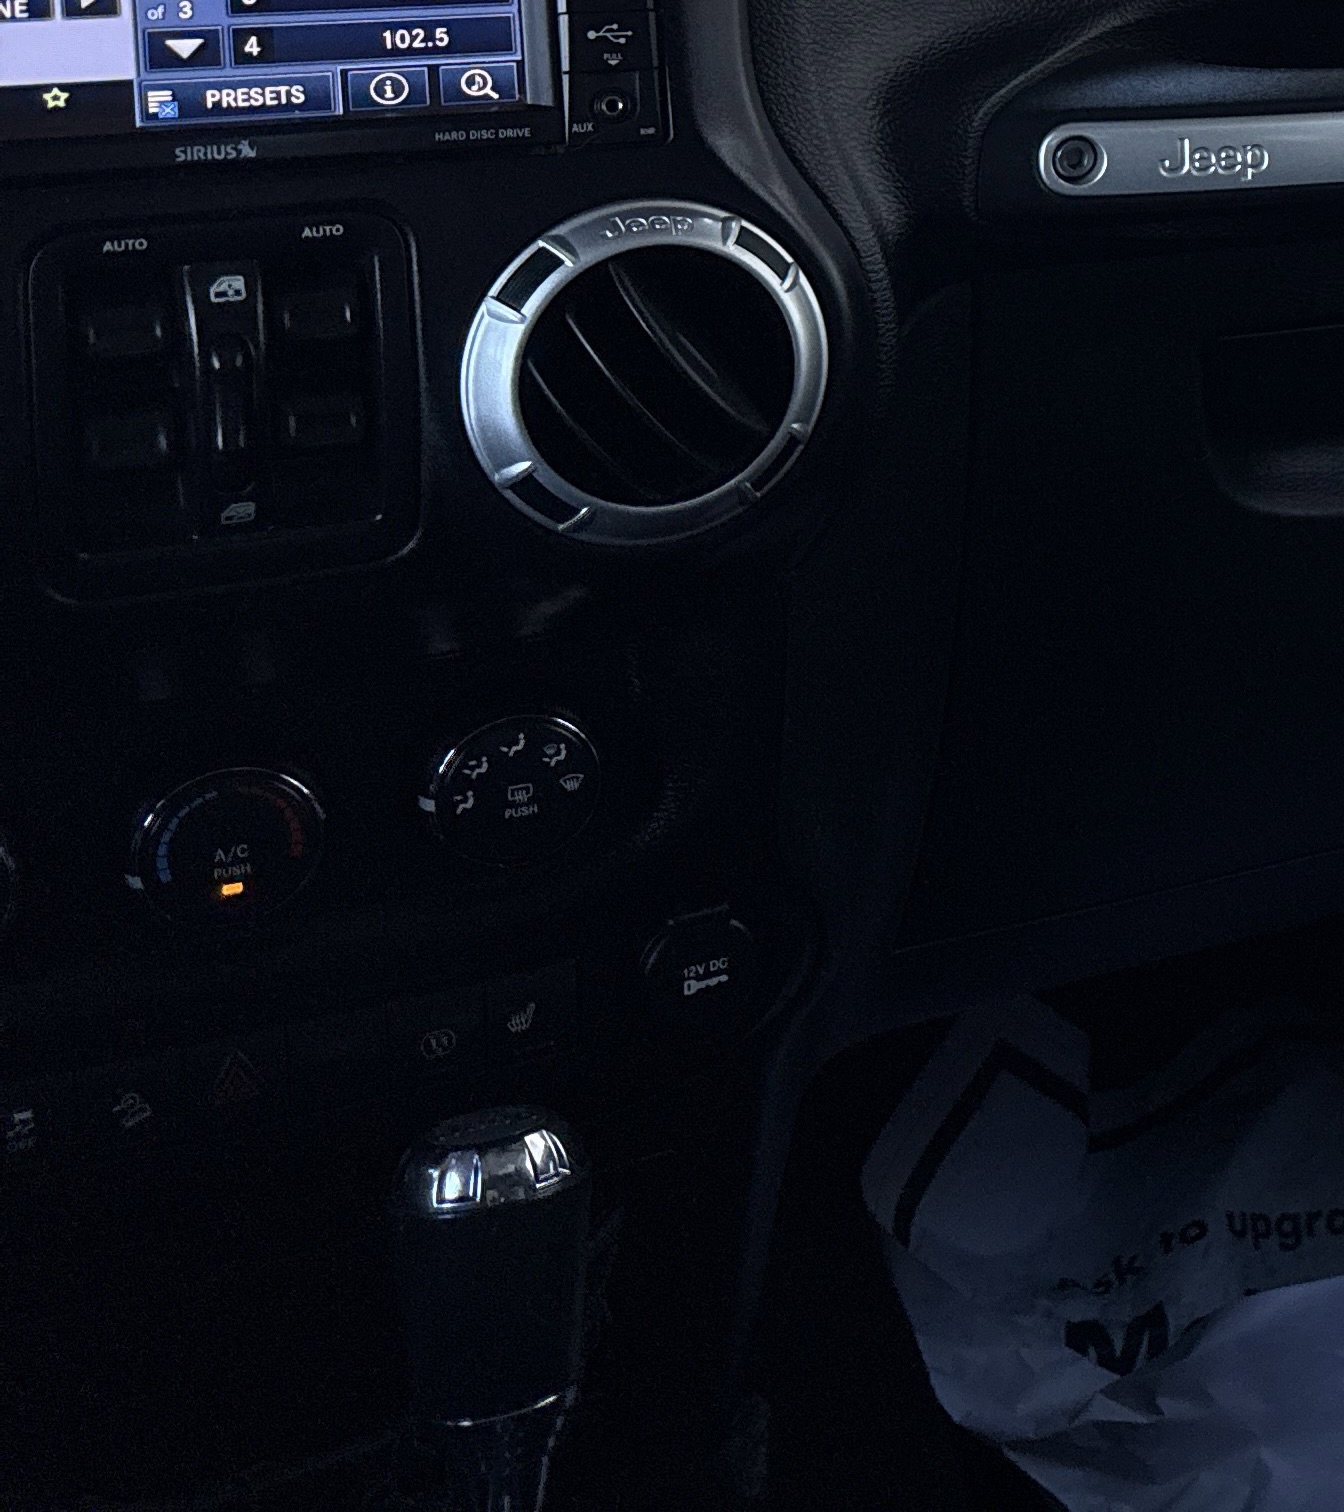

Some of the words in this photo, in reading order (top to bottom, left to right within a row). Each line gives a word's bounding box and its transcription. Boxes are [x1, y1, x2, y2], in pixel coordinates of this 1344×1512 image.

[146, 3, 165, 20] of
[178, 0, 193, 19] 3
[243, 35, 261, 56] 4
[382, 27, 449, 49] 102.5
[205, 84, 305, 108] PRESETS
[434, 131, 466, 142] HARD
[469, 129, 495, 140] DISC
[498, 128, 531, 139] DRIVE
[571, 122, 594, 133] AUX
[174, 144, 237, 162] SIRIUS
[1158, 137, 1269, 181] Jeep
[301, 224, 343, 238] AUTO
[601, 215, 694, 238] Jeep
[102, 238, 147, 253] AUTO
[504, 803, 538, 819] PUSH
[214, 843, 249, 862] A/C
[683, 962, 705, 978] 12V
[709, 957, 728, 971] DC
